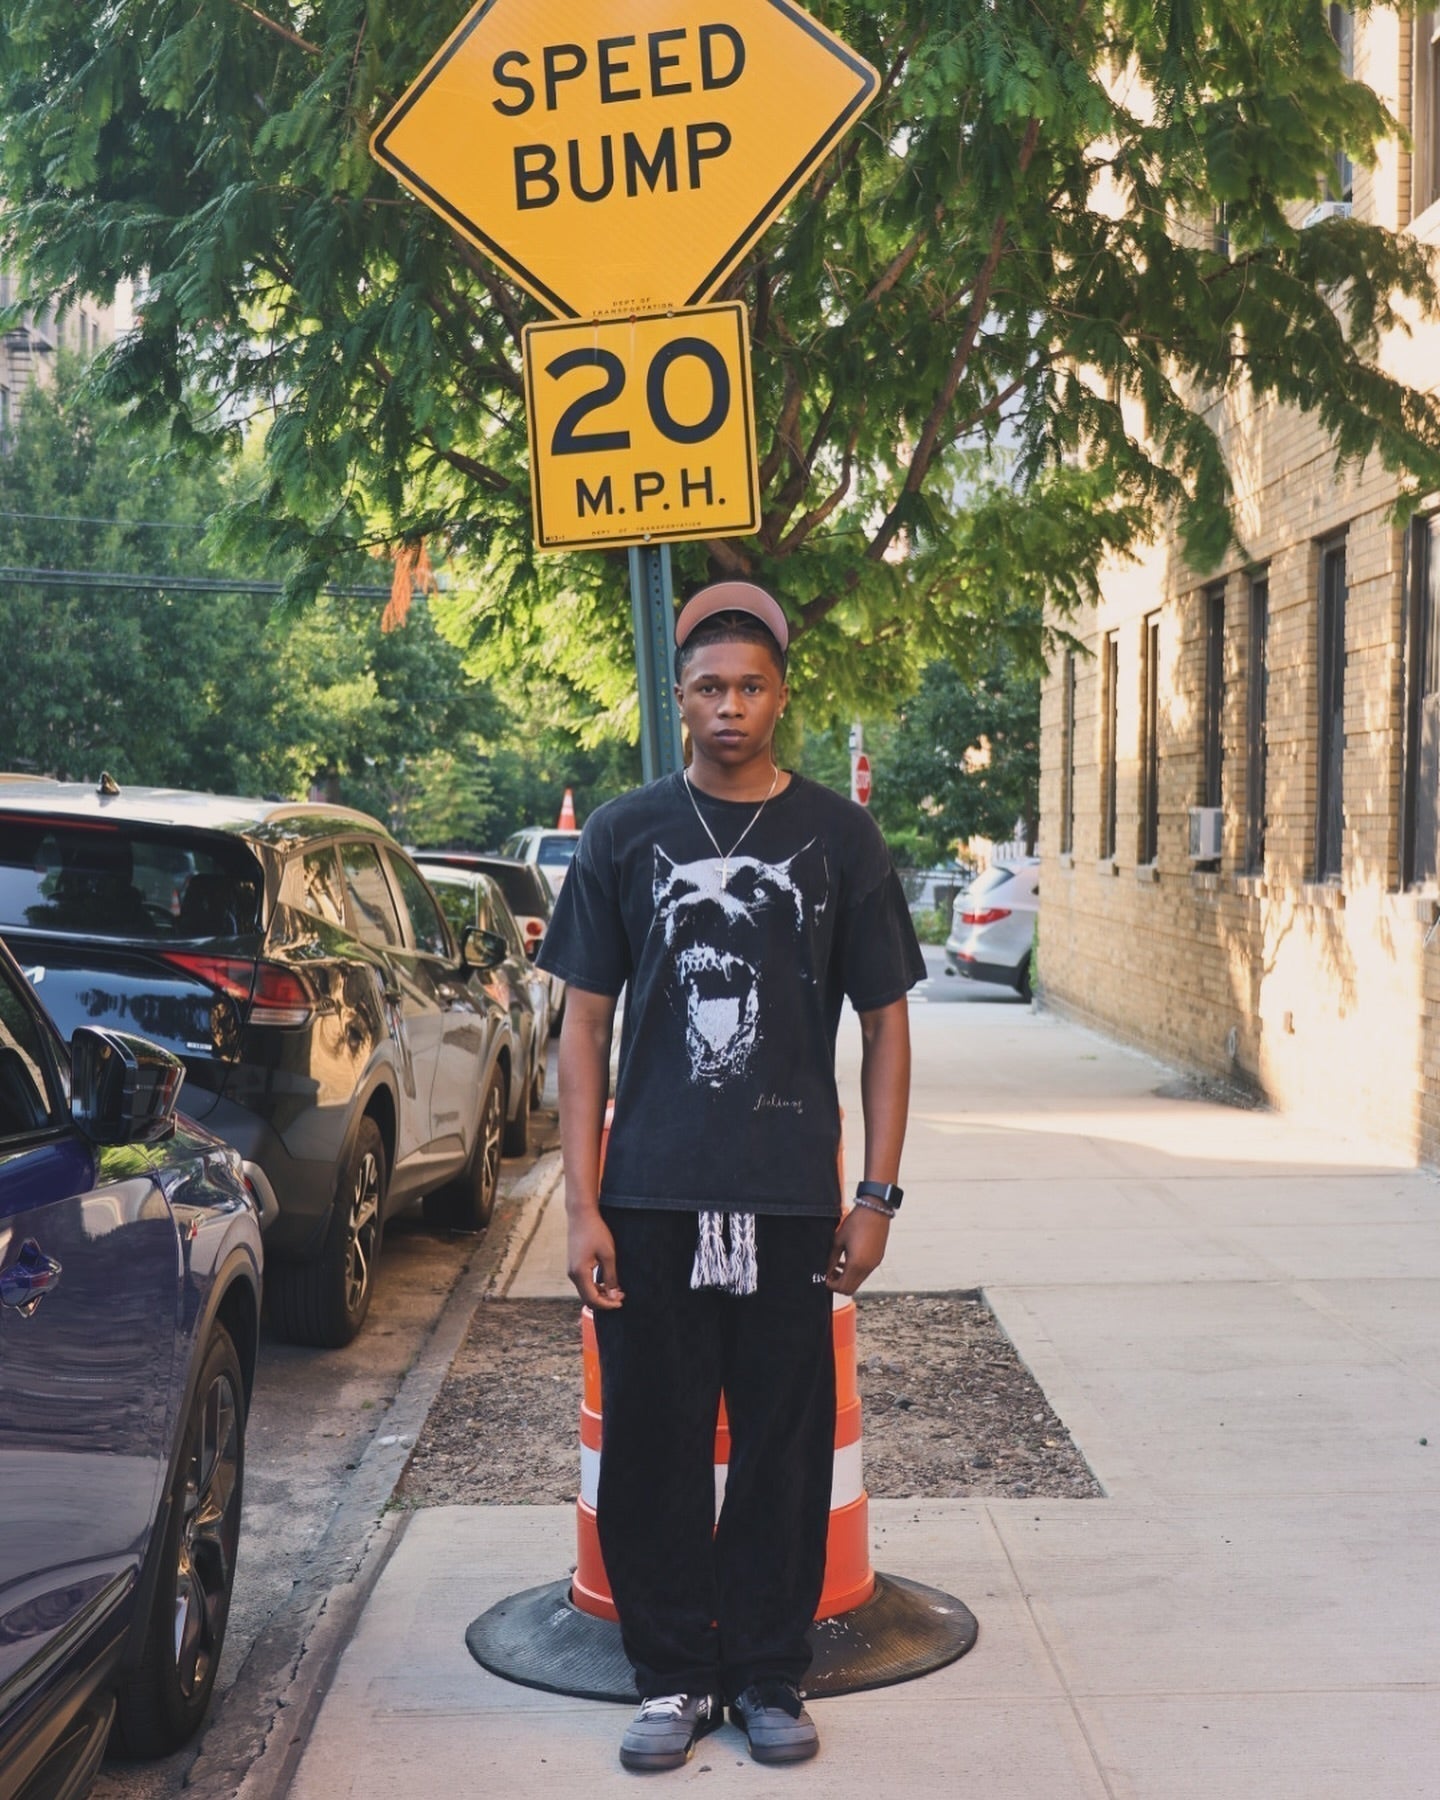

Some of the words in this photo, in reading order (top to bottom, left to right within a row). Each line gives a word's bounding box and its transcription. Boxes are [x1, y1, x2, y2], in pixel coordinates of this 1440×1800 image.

[492, 23, 746, 117] SPEED
[513, 121, 732, 211] BUMP
[592, 303, 673, 316] TRANSPORTATION
[544, 336, 731, 456] 20
[575, 466, 726, 518] M.P.H.
